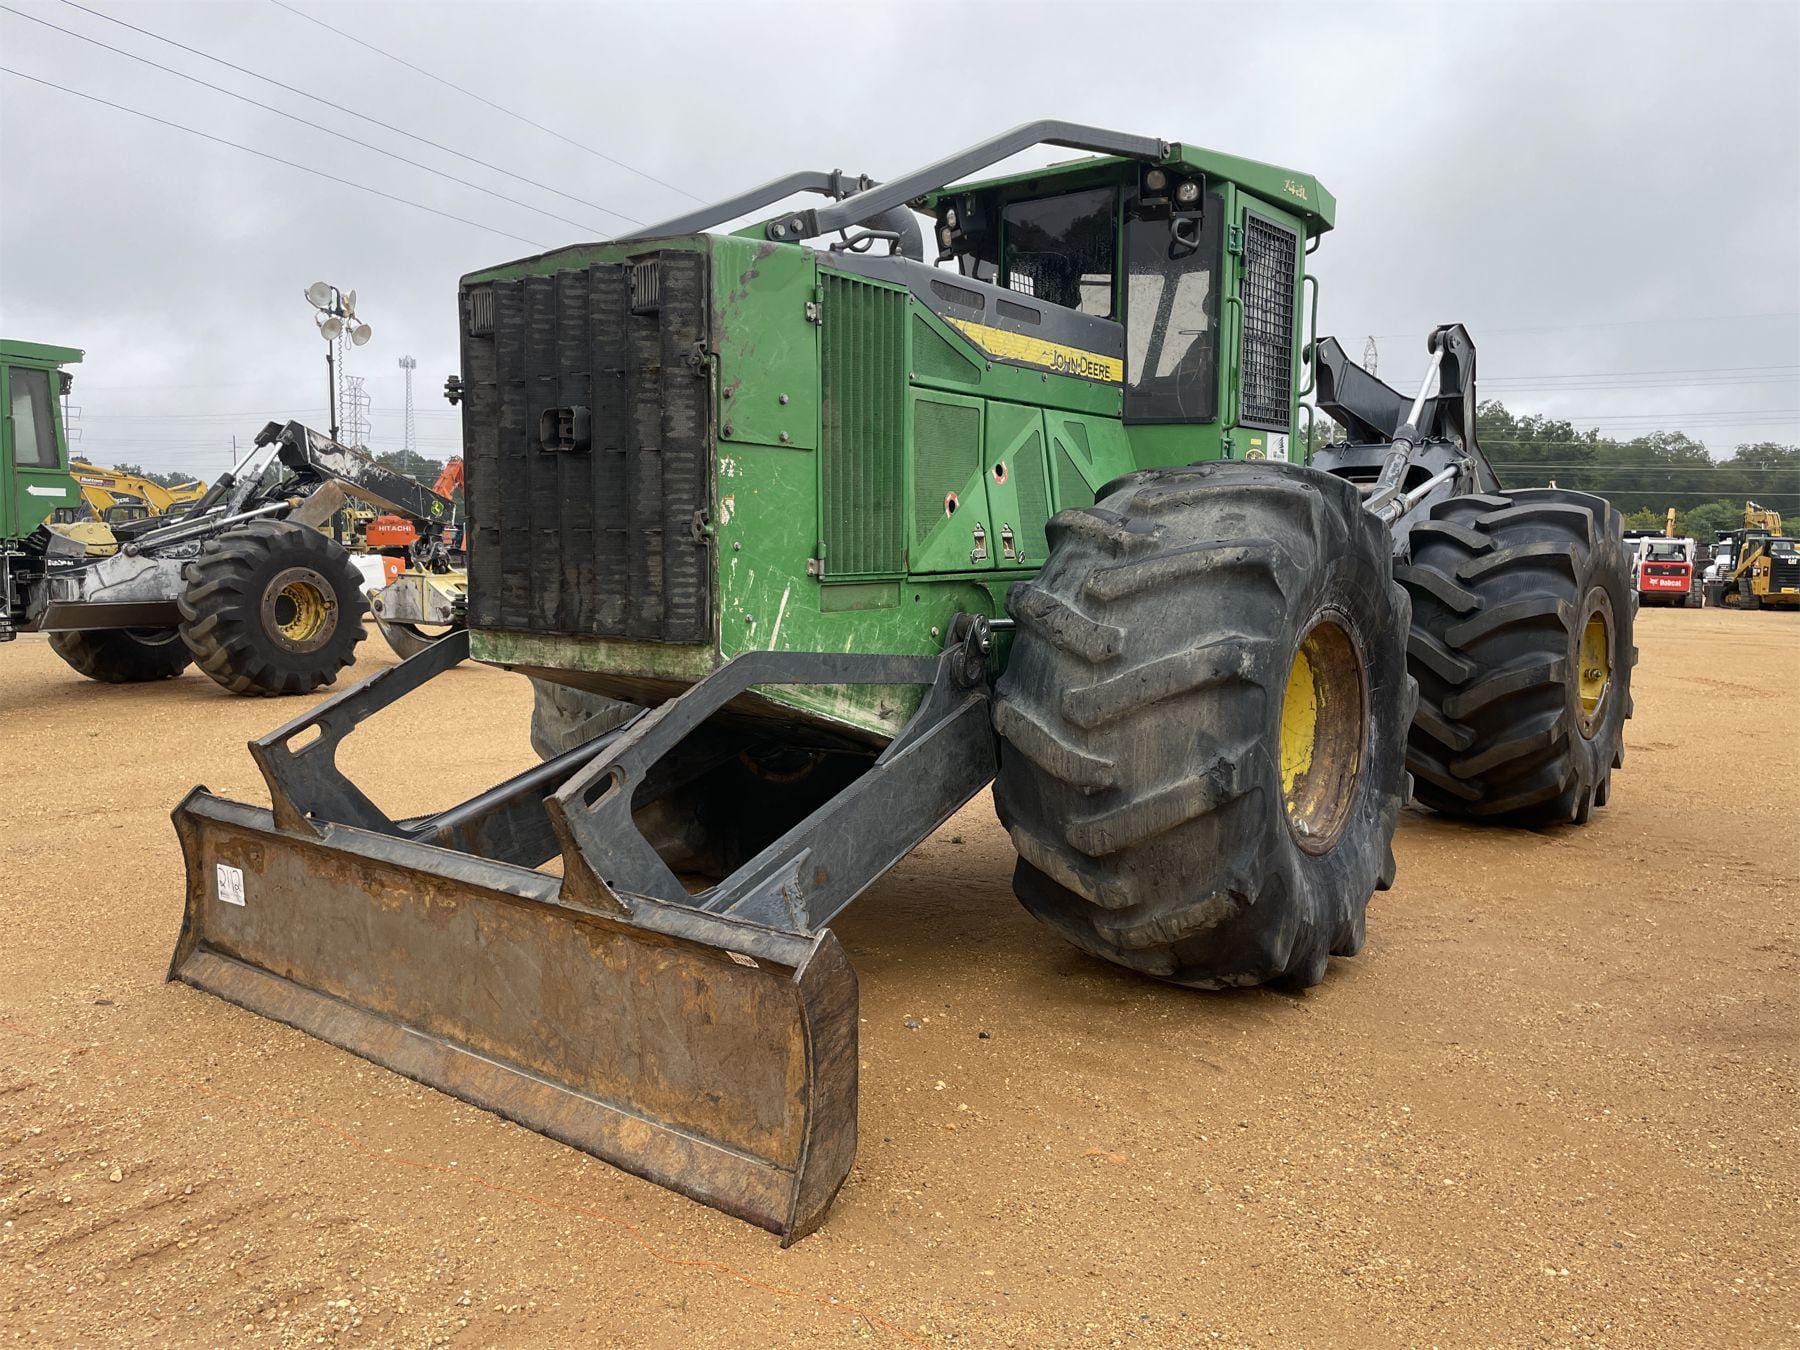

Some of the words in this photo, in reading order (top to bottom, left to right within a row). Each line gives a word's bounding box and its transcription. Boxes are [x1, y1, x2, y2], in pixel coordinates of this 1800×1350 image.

[1050, 349, 1078, 374] JOHN
[1080, 356, 1111, 379] DEERE
[1659, 579, 1682, 587] Bobcat
